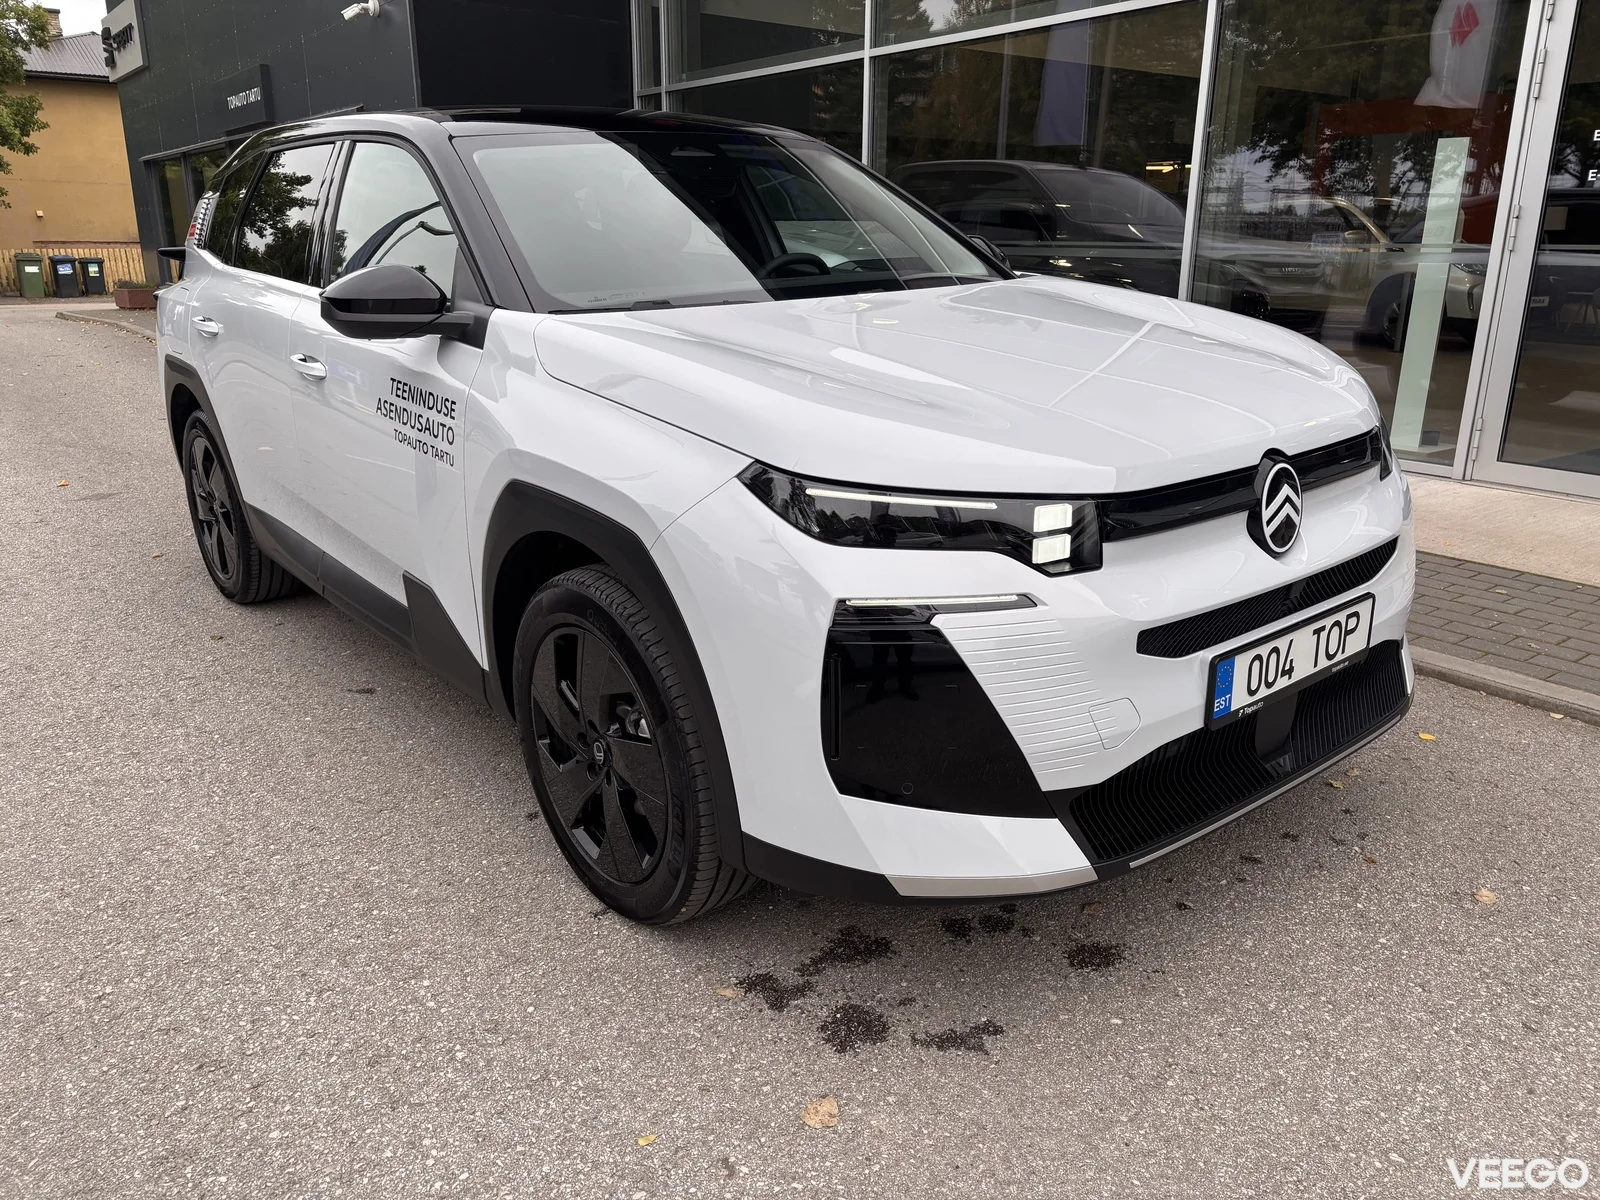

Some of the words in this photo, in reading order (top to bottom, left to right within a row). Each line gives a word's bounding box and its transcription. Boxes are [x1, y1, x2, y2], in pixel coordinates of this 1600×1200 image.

[390, 377, 457, 420] TEENINDUSE
[376, 397, 455, 446] ASENDUSAUTO
[394, 428, 428, 454] TOPAUTO
[430, 444, 455, 468] TARTU
[1246, 638, 1295, 697] 004
[1312, 610, 1361, 669] TOP
[1214, 694, 1231, 712] EST
[1244, 701, 1264, 715] Topauto
